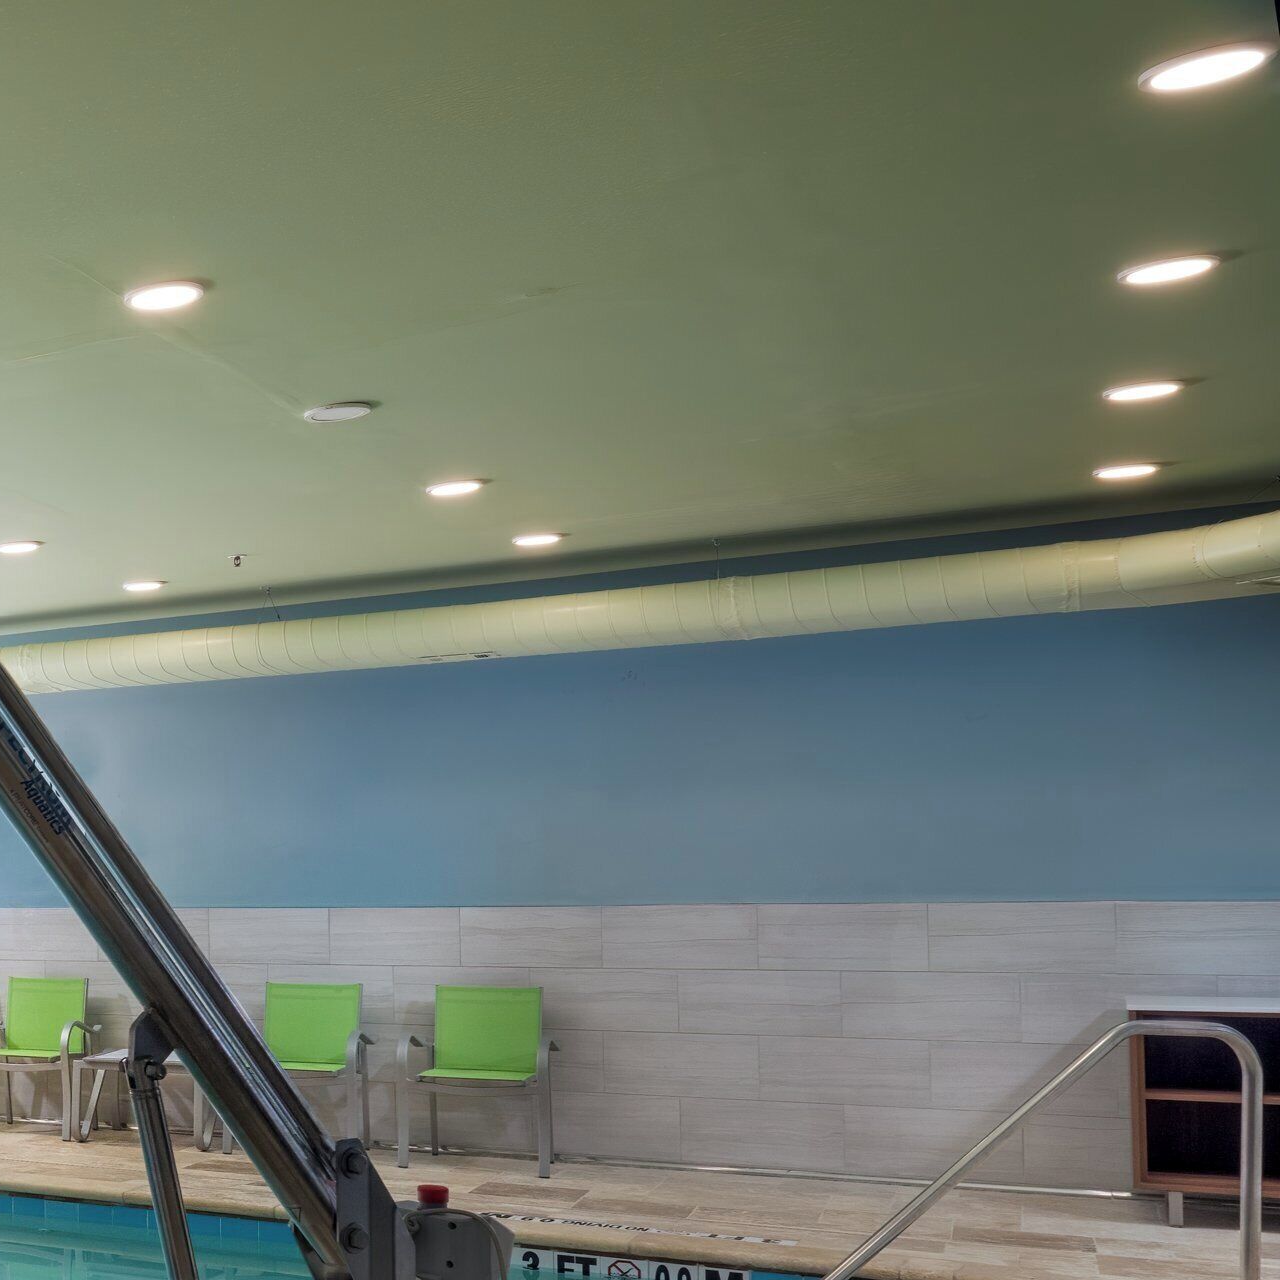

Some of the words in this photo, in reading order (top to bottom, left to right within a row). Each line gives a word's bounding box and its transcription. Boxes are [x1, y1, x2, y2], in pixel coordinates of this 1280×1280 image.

[20, 776, 65, 836] Aquatics
[522, 1250, 540, 1270] 3
[556, 1254, 597, 1277] FT
